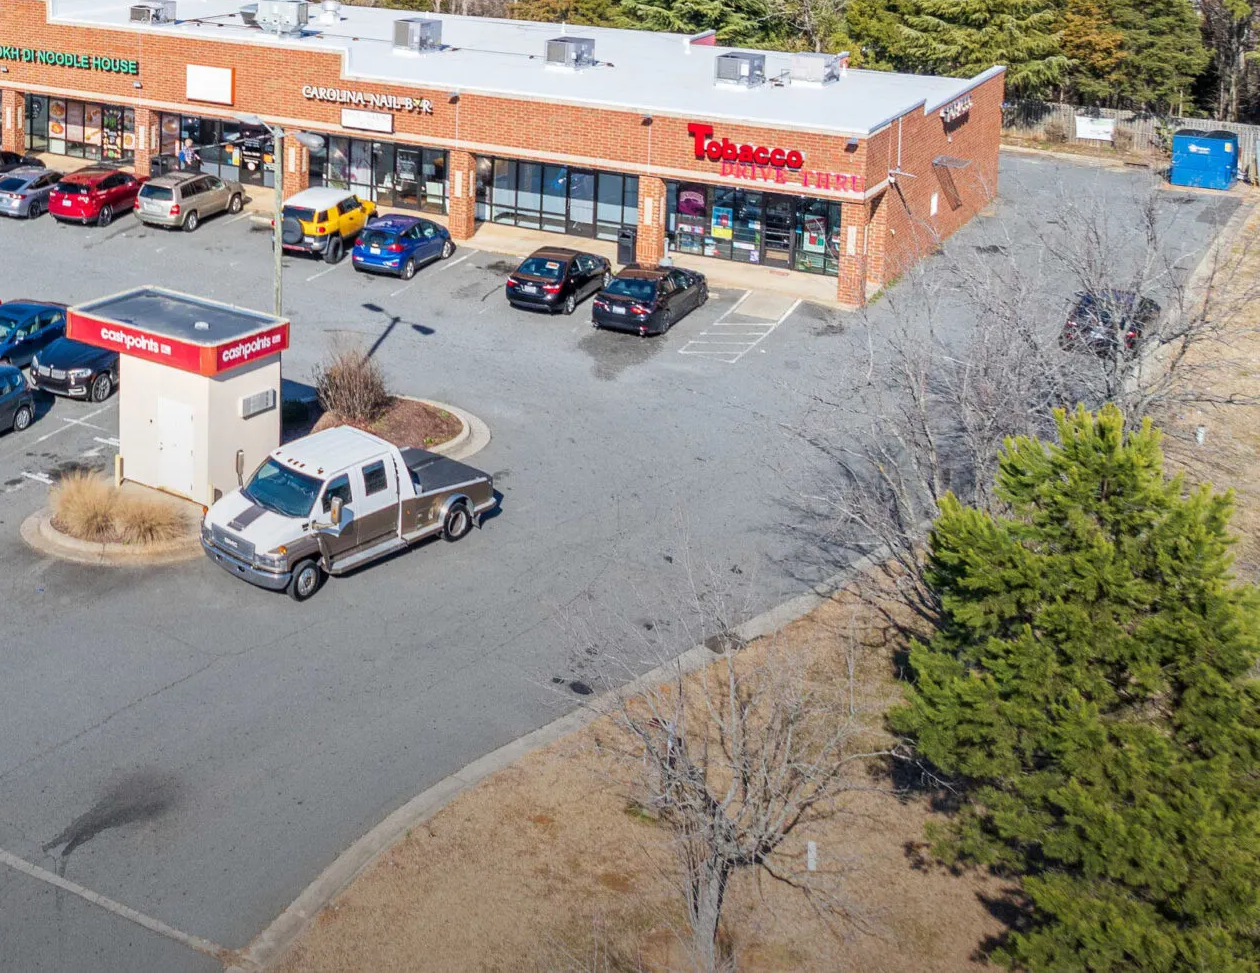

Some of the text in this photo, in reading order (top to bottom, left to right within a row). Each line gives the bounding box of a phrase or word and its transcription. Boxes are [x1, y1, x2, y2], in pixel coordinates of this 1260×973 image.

[22, 48, 35, 62] DI
[37, 50, 89, 68] NOODLE
[92, 57, 138, 74] HOUSE
[302, 86, 366, 105] CAROLINA
[369, 94, 401, 109] NAIL
[687, 122, 803, 168] Tobacco
[720, 161, 866, 193] DRIVE THRU
[100, 327, 159, 354] cashpoints
[222, 335, 271, 362] cashpoints
